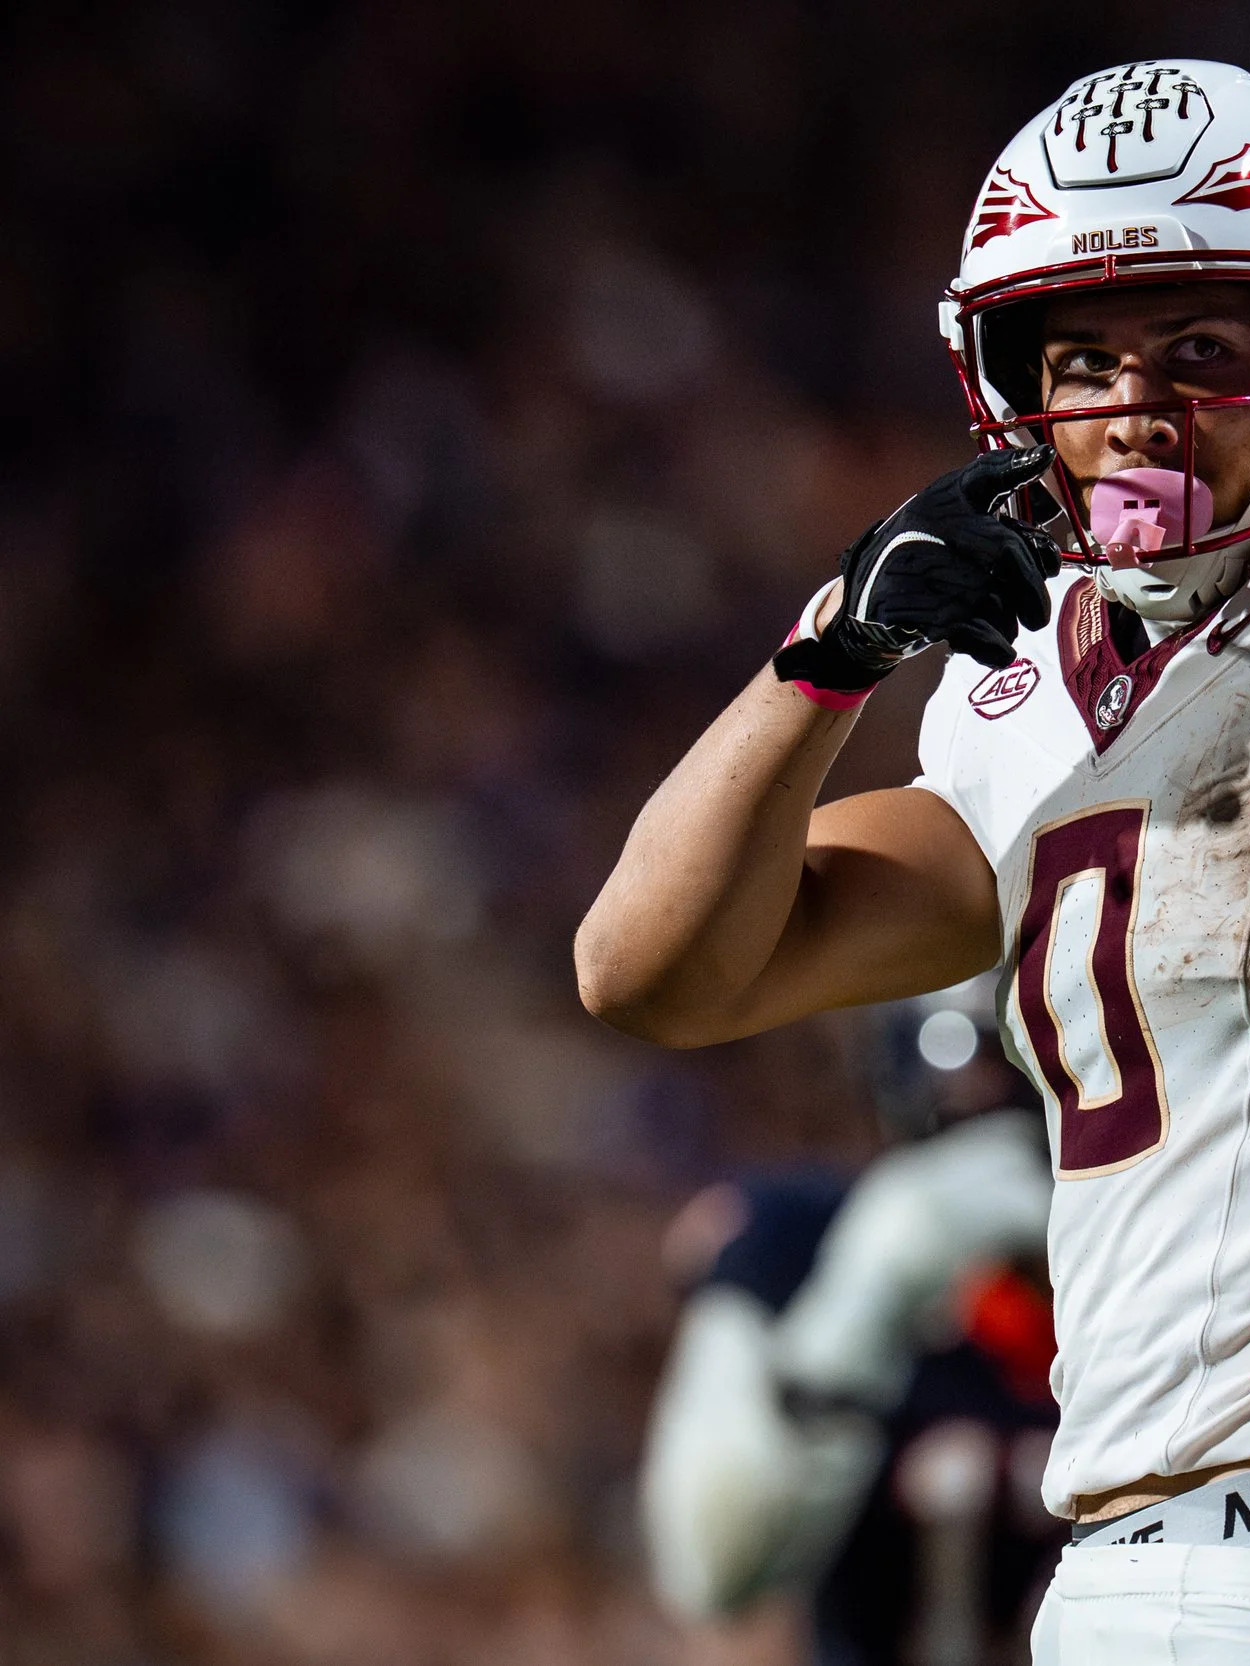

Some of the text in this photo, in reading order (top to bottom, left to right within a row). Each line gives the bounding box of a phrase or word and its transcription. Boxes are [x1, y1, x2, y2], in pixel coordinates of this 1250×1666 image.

[1072, 226, 1158, 254] NOLES
[979, 667, 1032, 700] ACC
[1014, 798, 1171, 1181] 0
